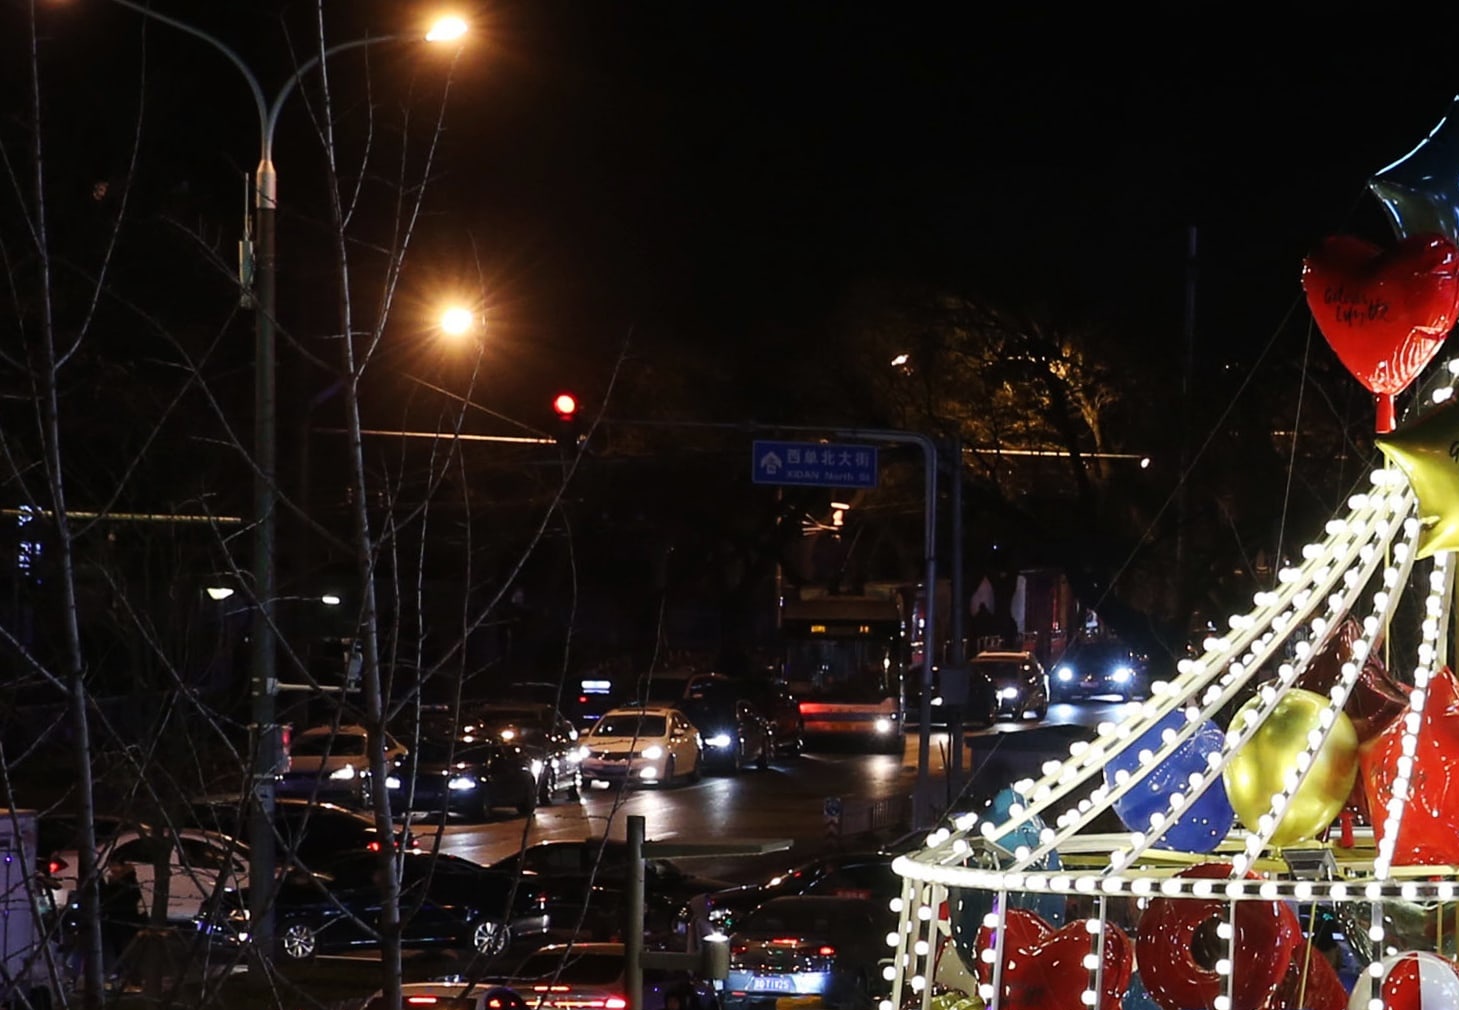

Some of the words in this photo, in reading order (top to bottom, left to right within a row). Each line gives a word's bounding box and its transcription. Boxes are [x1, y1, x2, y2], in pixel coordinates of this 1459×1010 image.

[787, 448, 871, 467] 西单北大街
[824, 472, 854, 481] North
